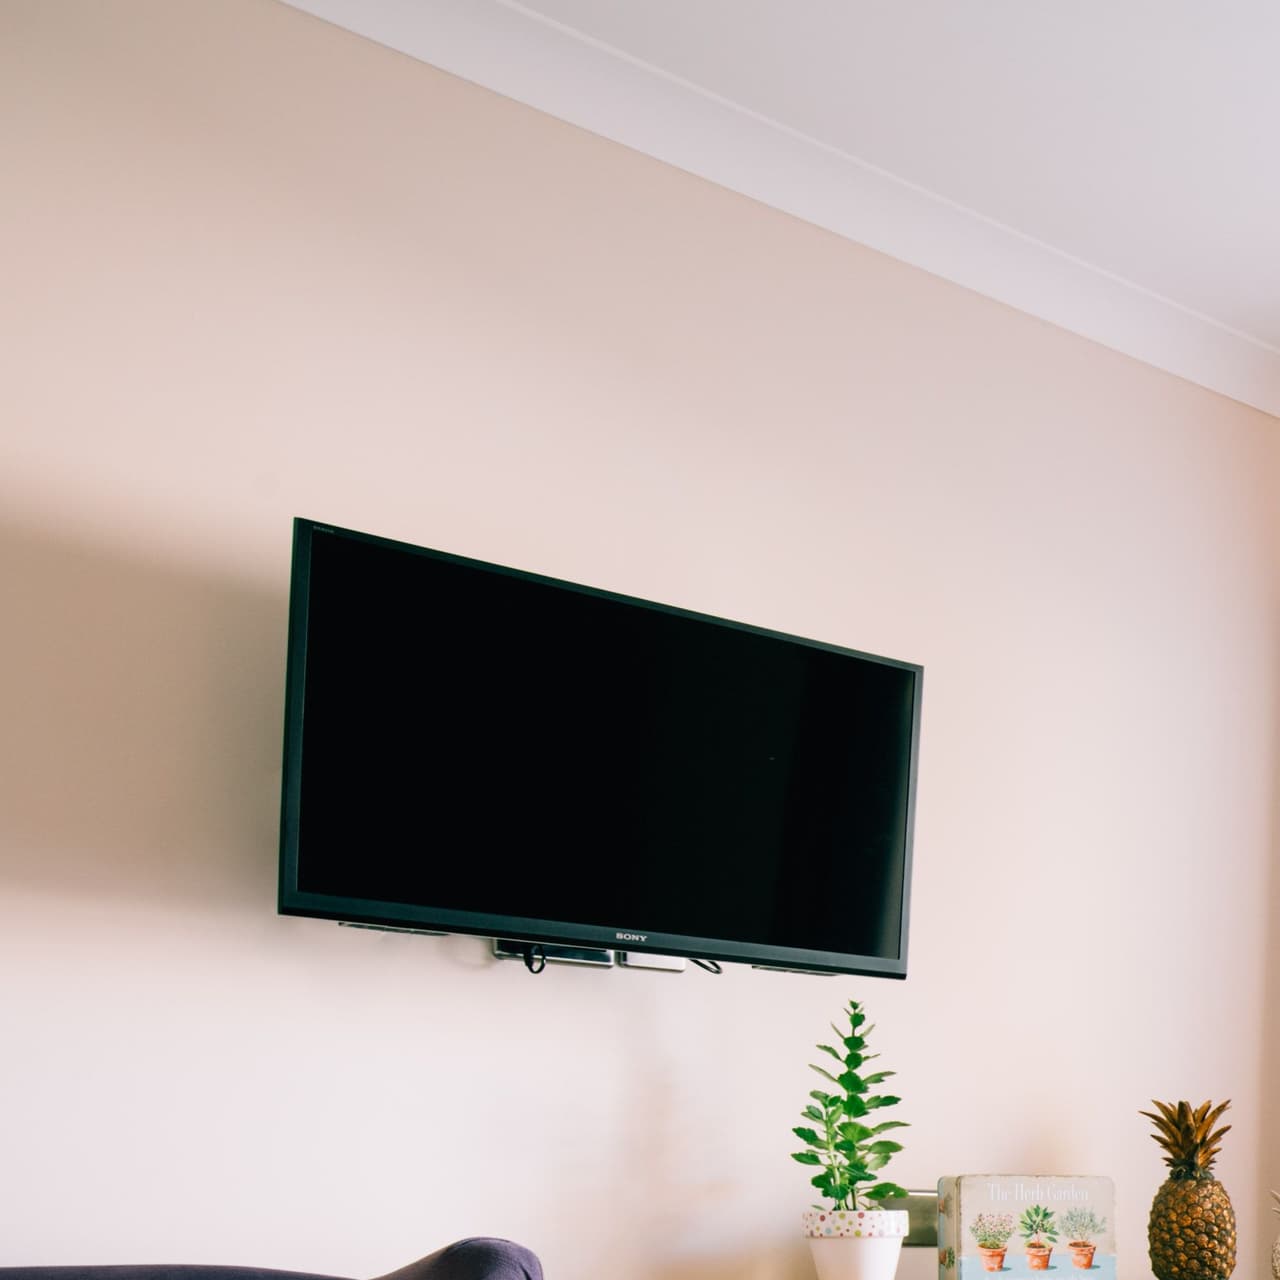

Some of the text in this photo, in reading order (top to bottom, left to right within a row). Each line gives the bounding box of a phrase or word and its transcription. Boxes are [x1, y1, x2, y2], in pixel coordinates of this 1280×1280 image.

[616, 932, 647, 942] SONY
[986, 1183, 1089, 1201] The Herb Garden
